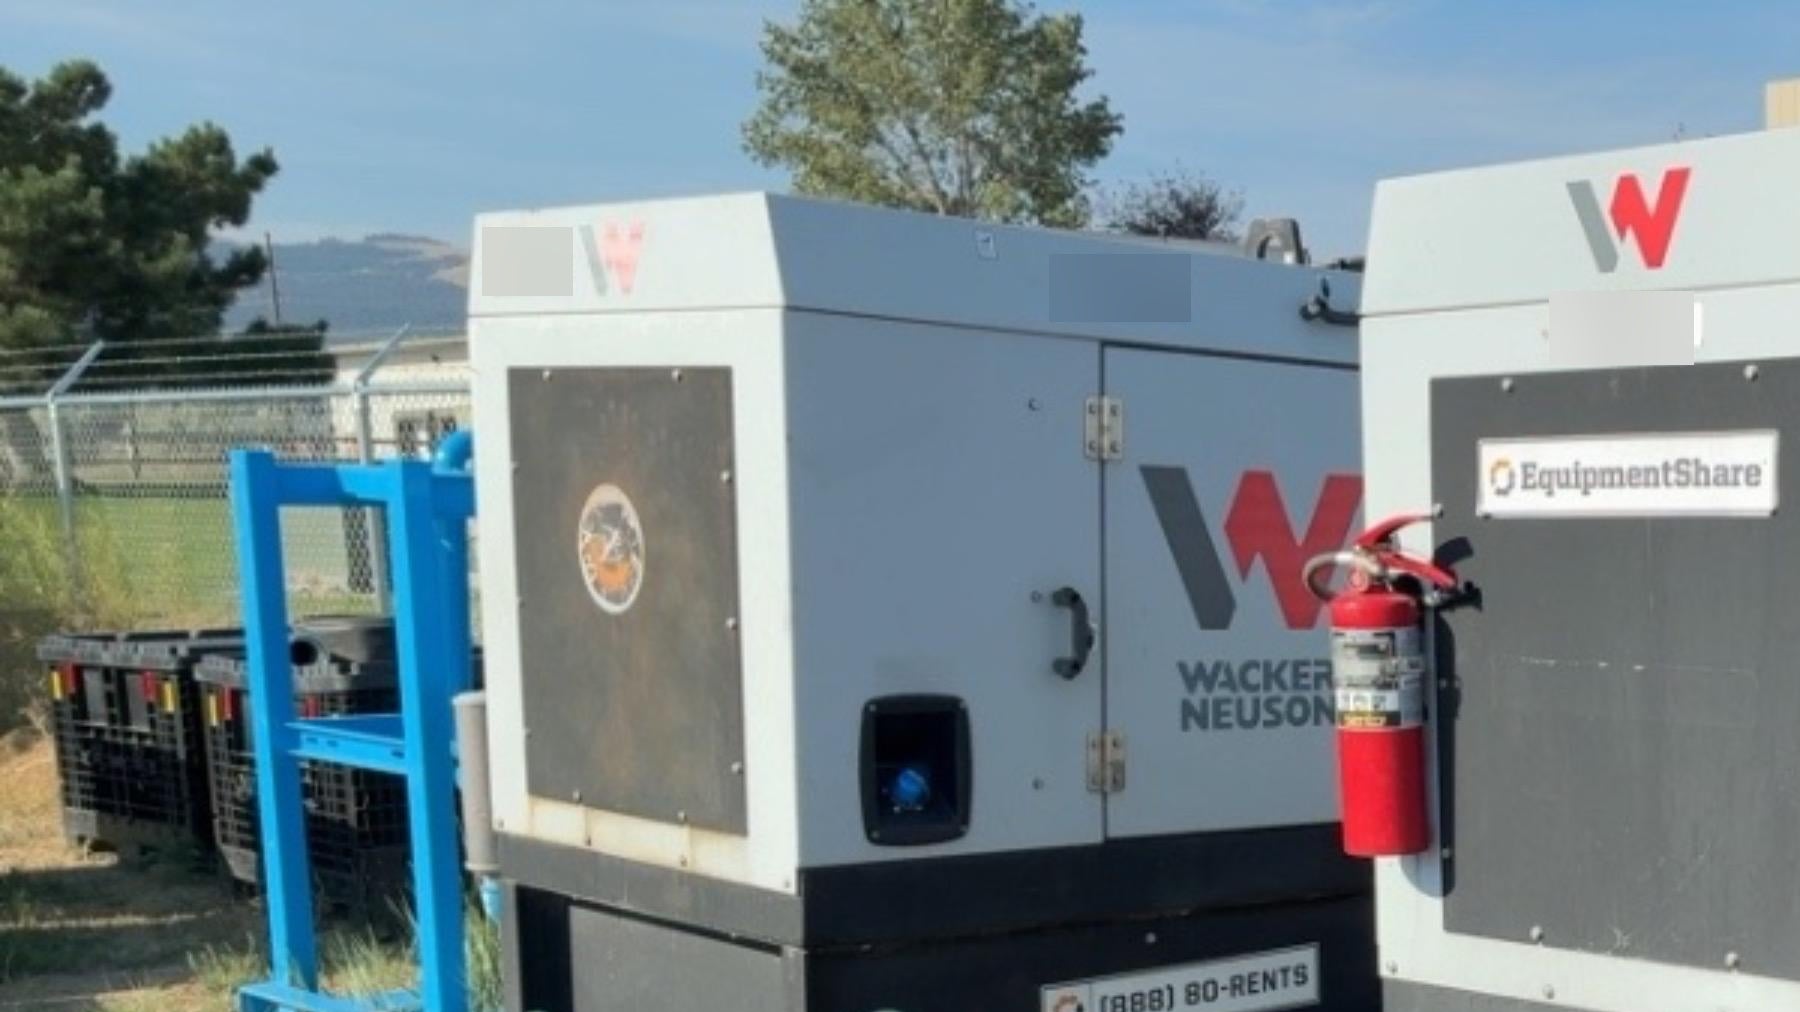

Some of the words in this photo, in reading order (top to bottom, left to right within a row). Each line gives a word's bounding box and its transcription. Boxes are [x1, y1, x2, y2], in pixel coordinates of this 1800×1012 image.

[1520, 457, 1763, 497] EquipmentShare
[1176, 659, 1334, 694] WACKER
[1180, 695, 1336, 733] NEUSON
[1184, 964, 1309, 1006] 80-RENTS
